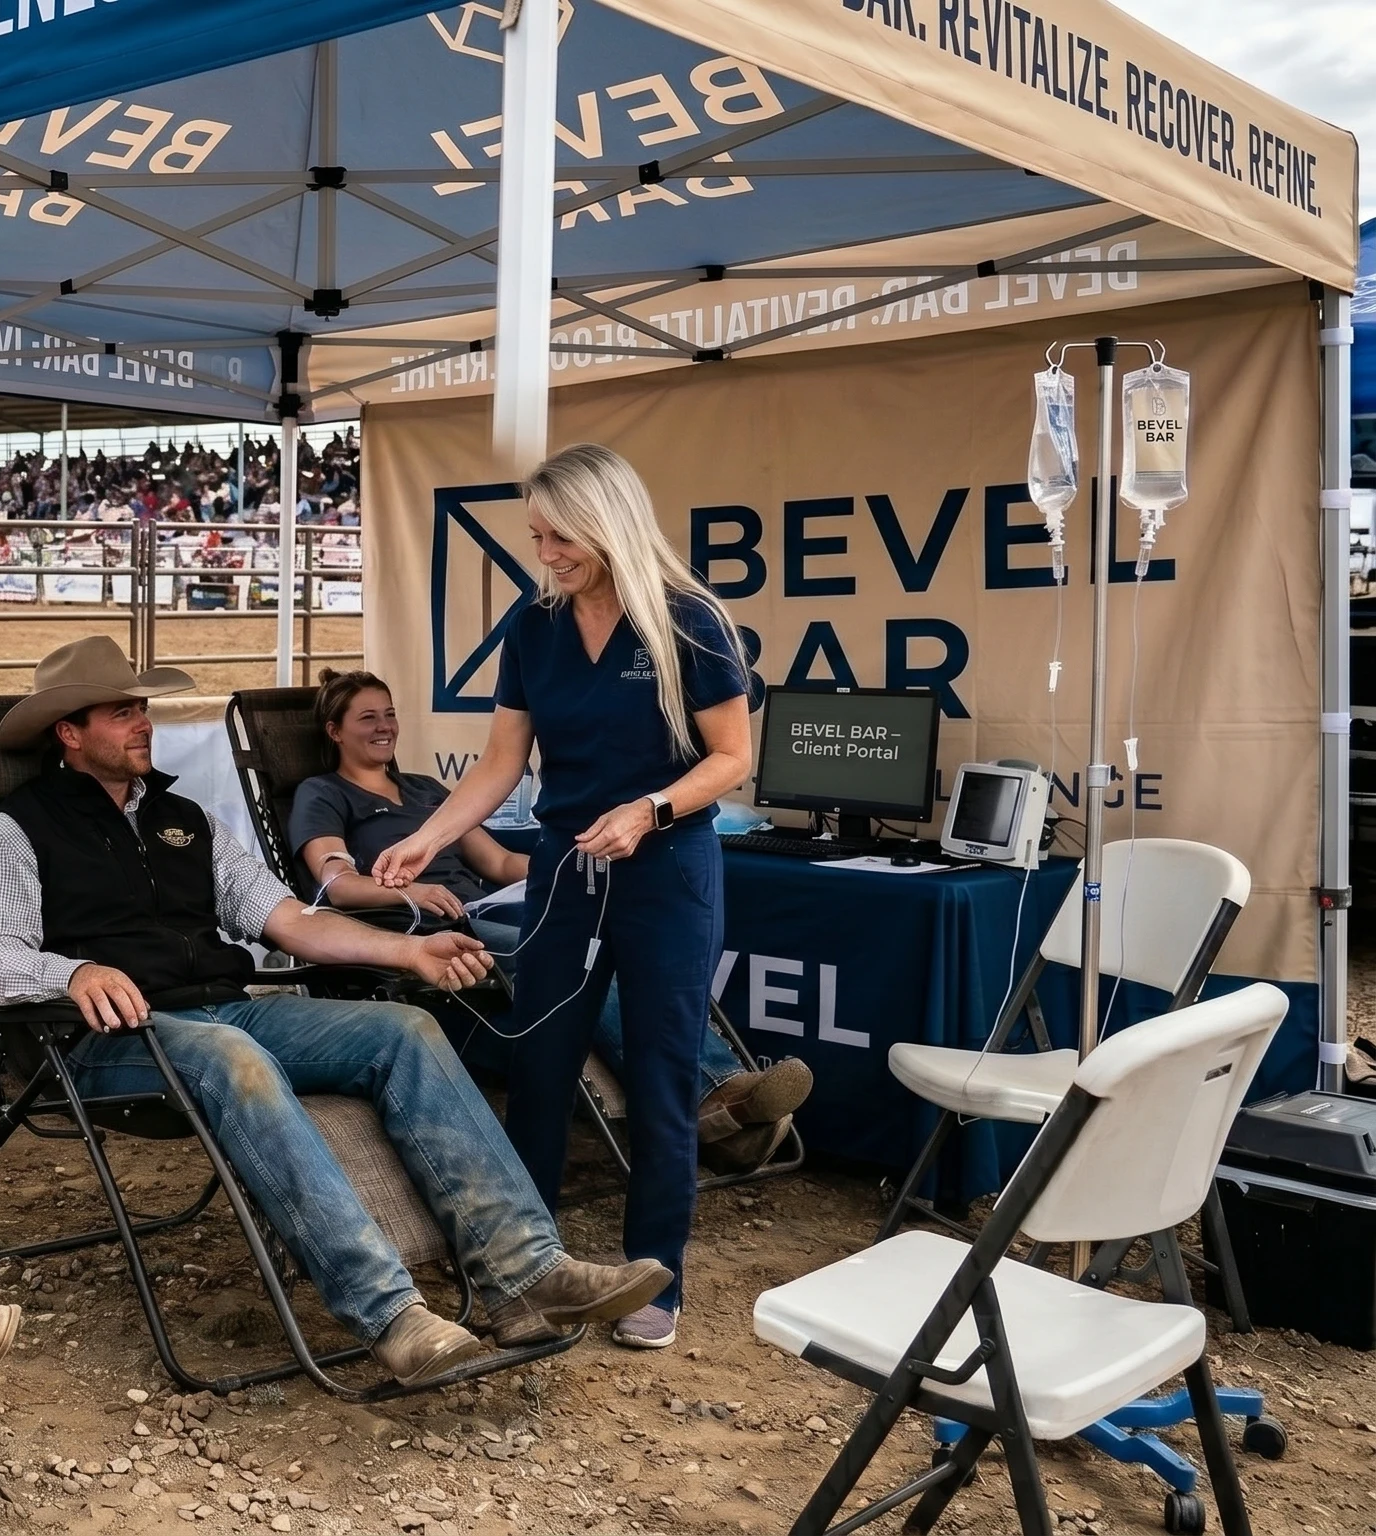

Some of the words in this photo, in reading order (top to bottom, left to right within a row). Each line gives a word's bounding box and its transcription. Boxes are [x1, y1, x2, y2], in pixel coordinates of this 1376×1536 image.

[939, 0, 1118, 124] REVITALIZE.
[1126, 60, 1242, 181] RECOVER.
[1249, 123, 1322, 218] REFINE.
[1137, 420, 1183, 430] BEVEL
[1146, 432, 1175, 442] BAR
[689, 475, 1177, 600] BEVEL
[791, 723, 845, 738] BEVEL
[850, 725, 887, 740] BAR
[792, 741, 841, 757] Client
[846, 743, 899, 760] Portal
